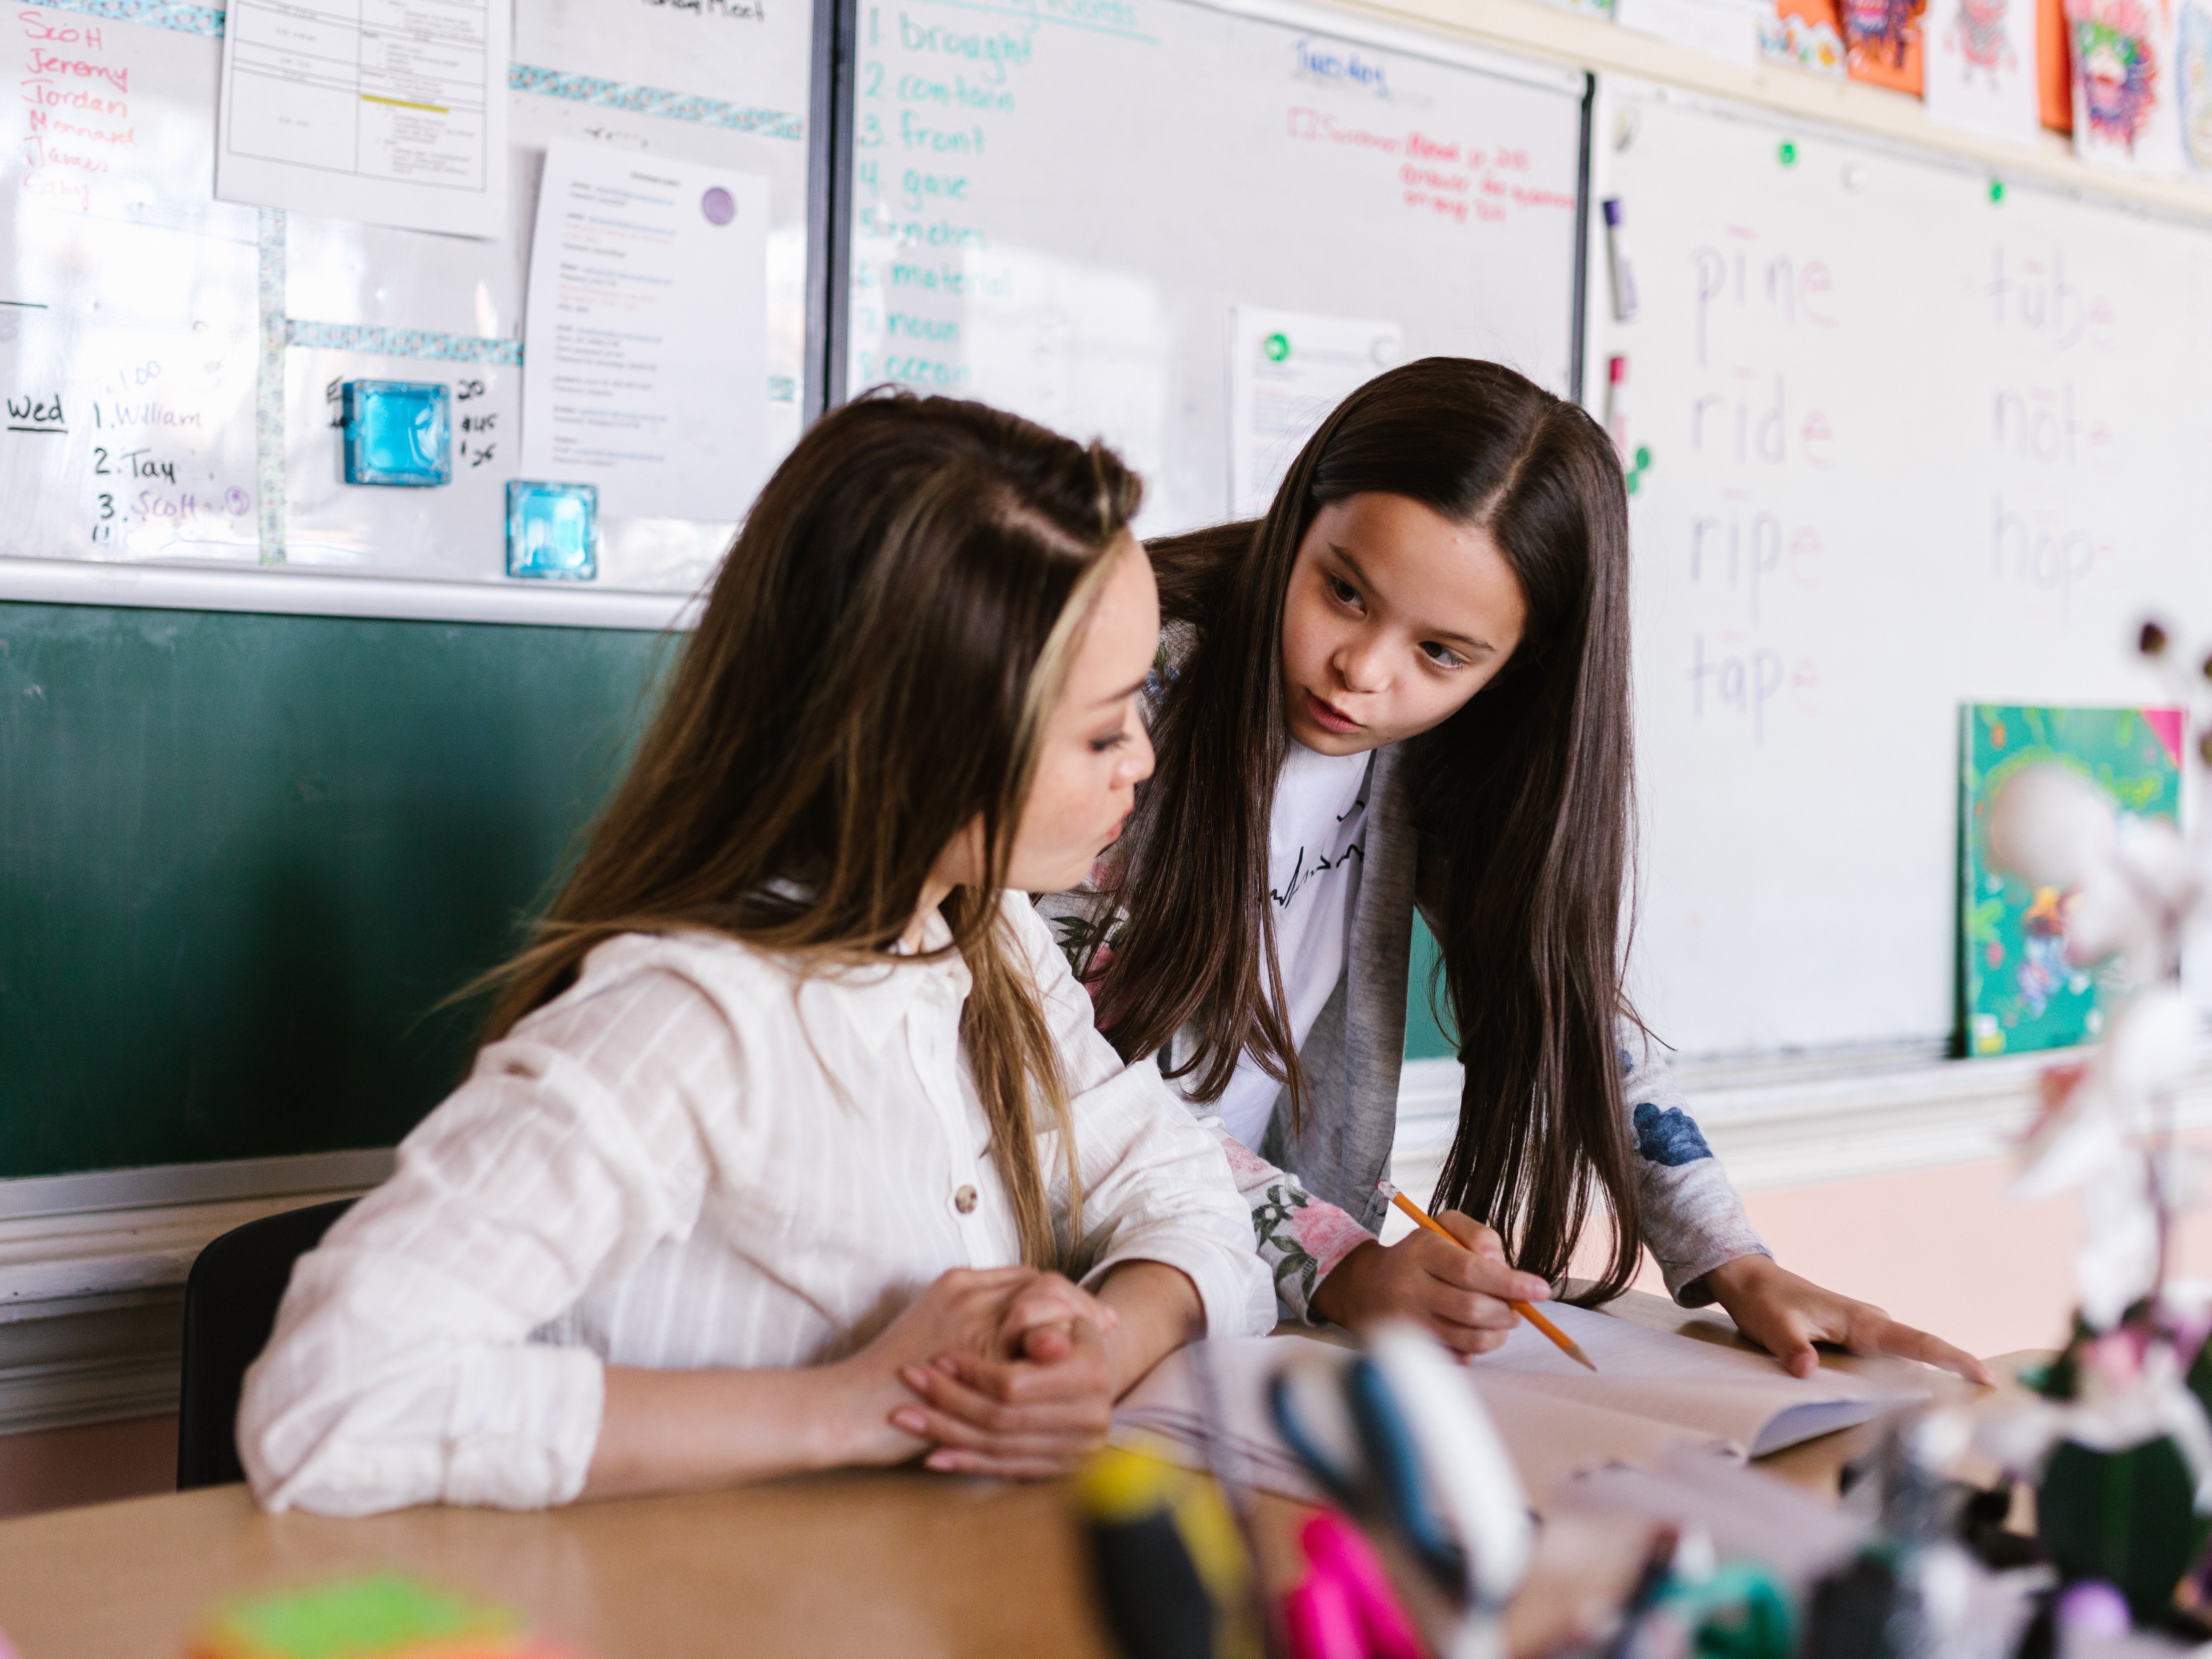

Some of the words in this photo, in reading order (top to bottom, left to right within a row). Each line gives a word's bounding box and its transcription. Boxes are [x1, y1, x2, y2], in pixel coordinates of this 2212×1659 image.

[899, 10, 1032, 84] brought
[26, 47, 128, 93] Jeremy
[1290, 37, 1392, 100] Tuesday
[21, 78, 127, 118] Jordan
[897, 73, 1015, 113] contain
[900, 110, 985, 154] front
[902, 168, 968, 212] gave
[888, 311, 960, 343] noun
[8, 394, 65, 423] Wed
[116, 402, 202, 427] William
[94, 447, 121, 474] 2.
[121, 448, 176, 484] Tay
[131, 490, 195, 516] Scott
